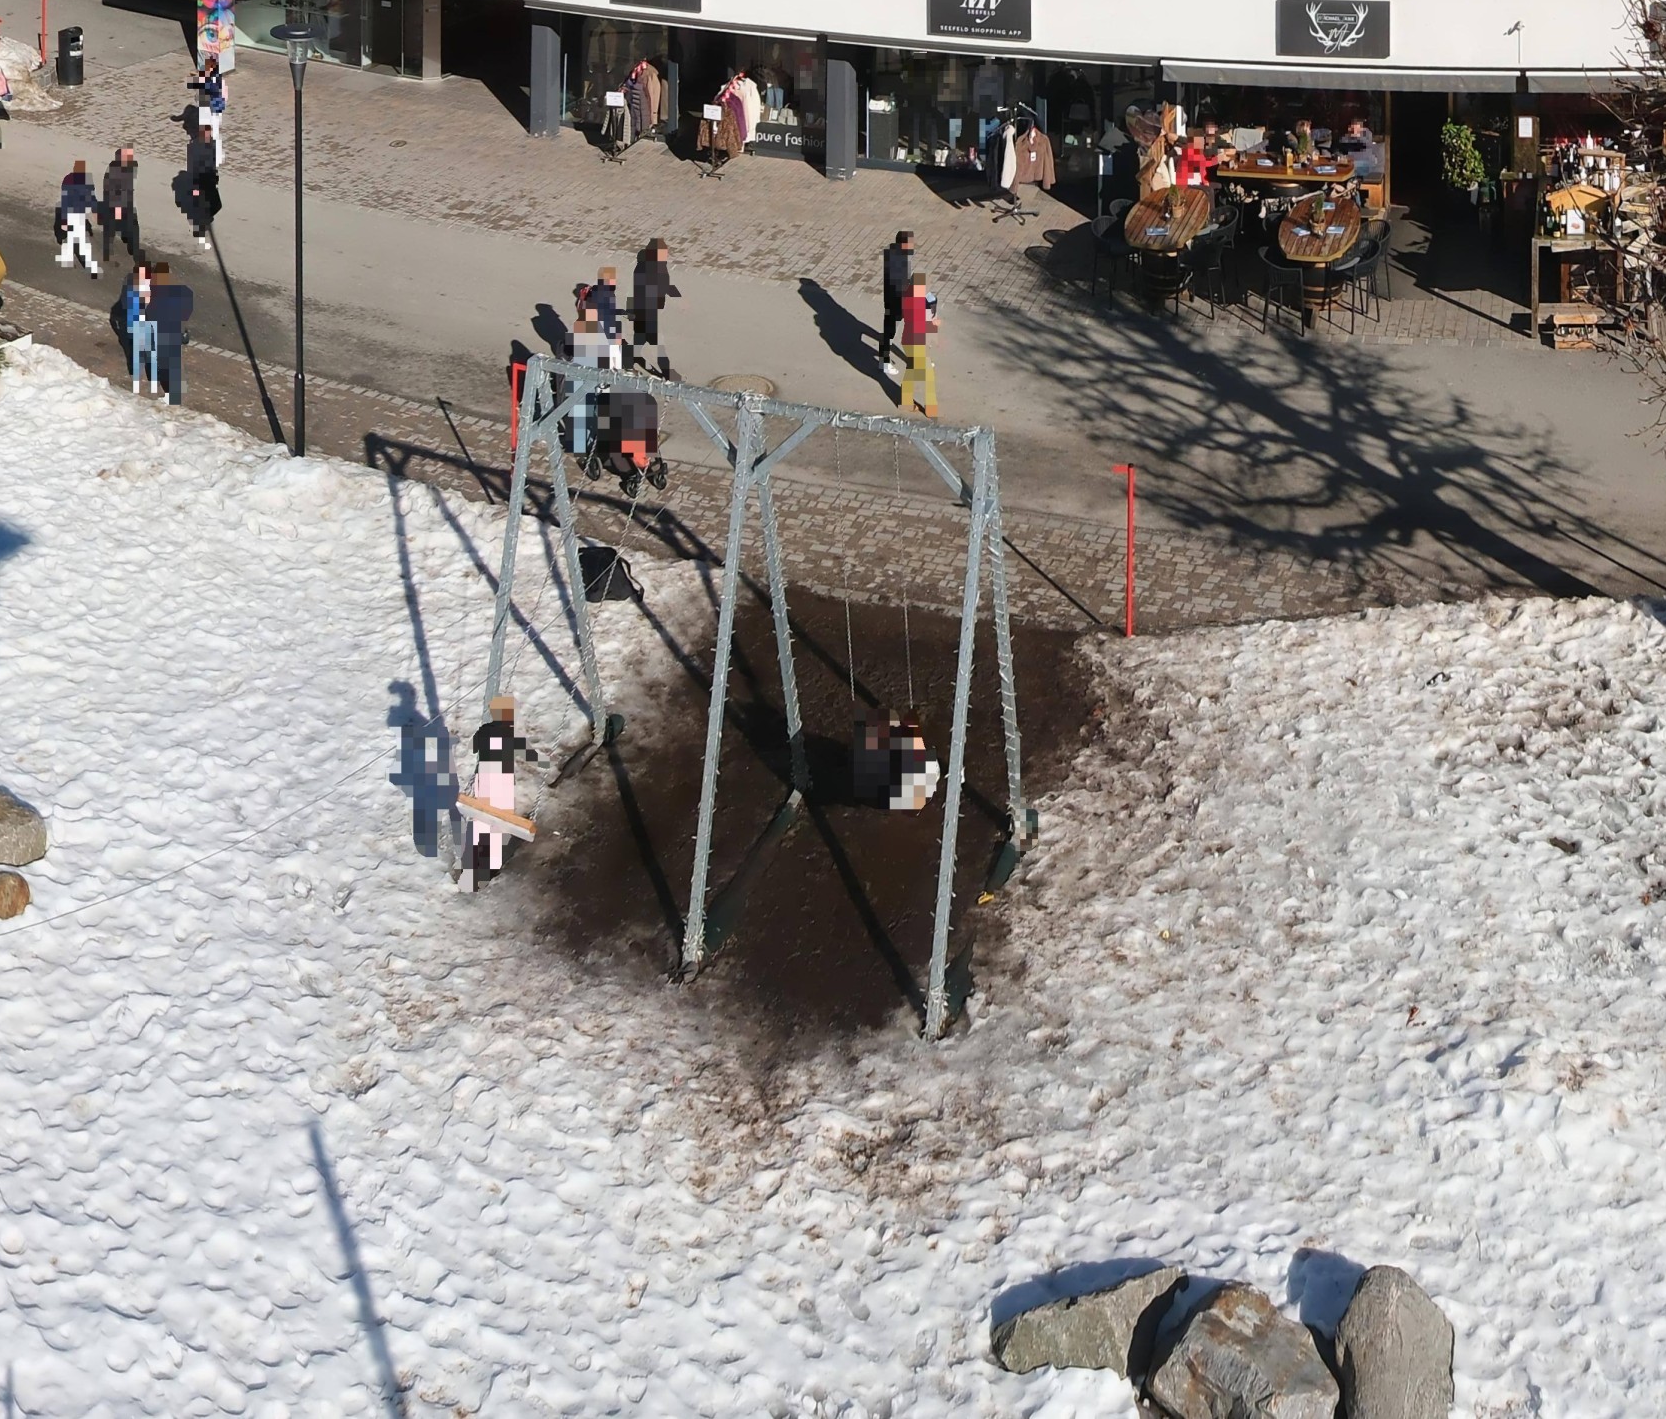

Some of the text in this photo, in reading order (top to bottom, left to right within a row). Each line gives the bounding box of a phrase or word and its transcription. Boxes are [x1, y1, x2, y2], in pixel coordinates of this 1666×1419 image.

[967, 8, 996, 16] SEEFELD
[971, 27, 1006, 35] SHOPPING
[756, 132, 782, 143] pure
